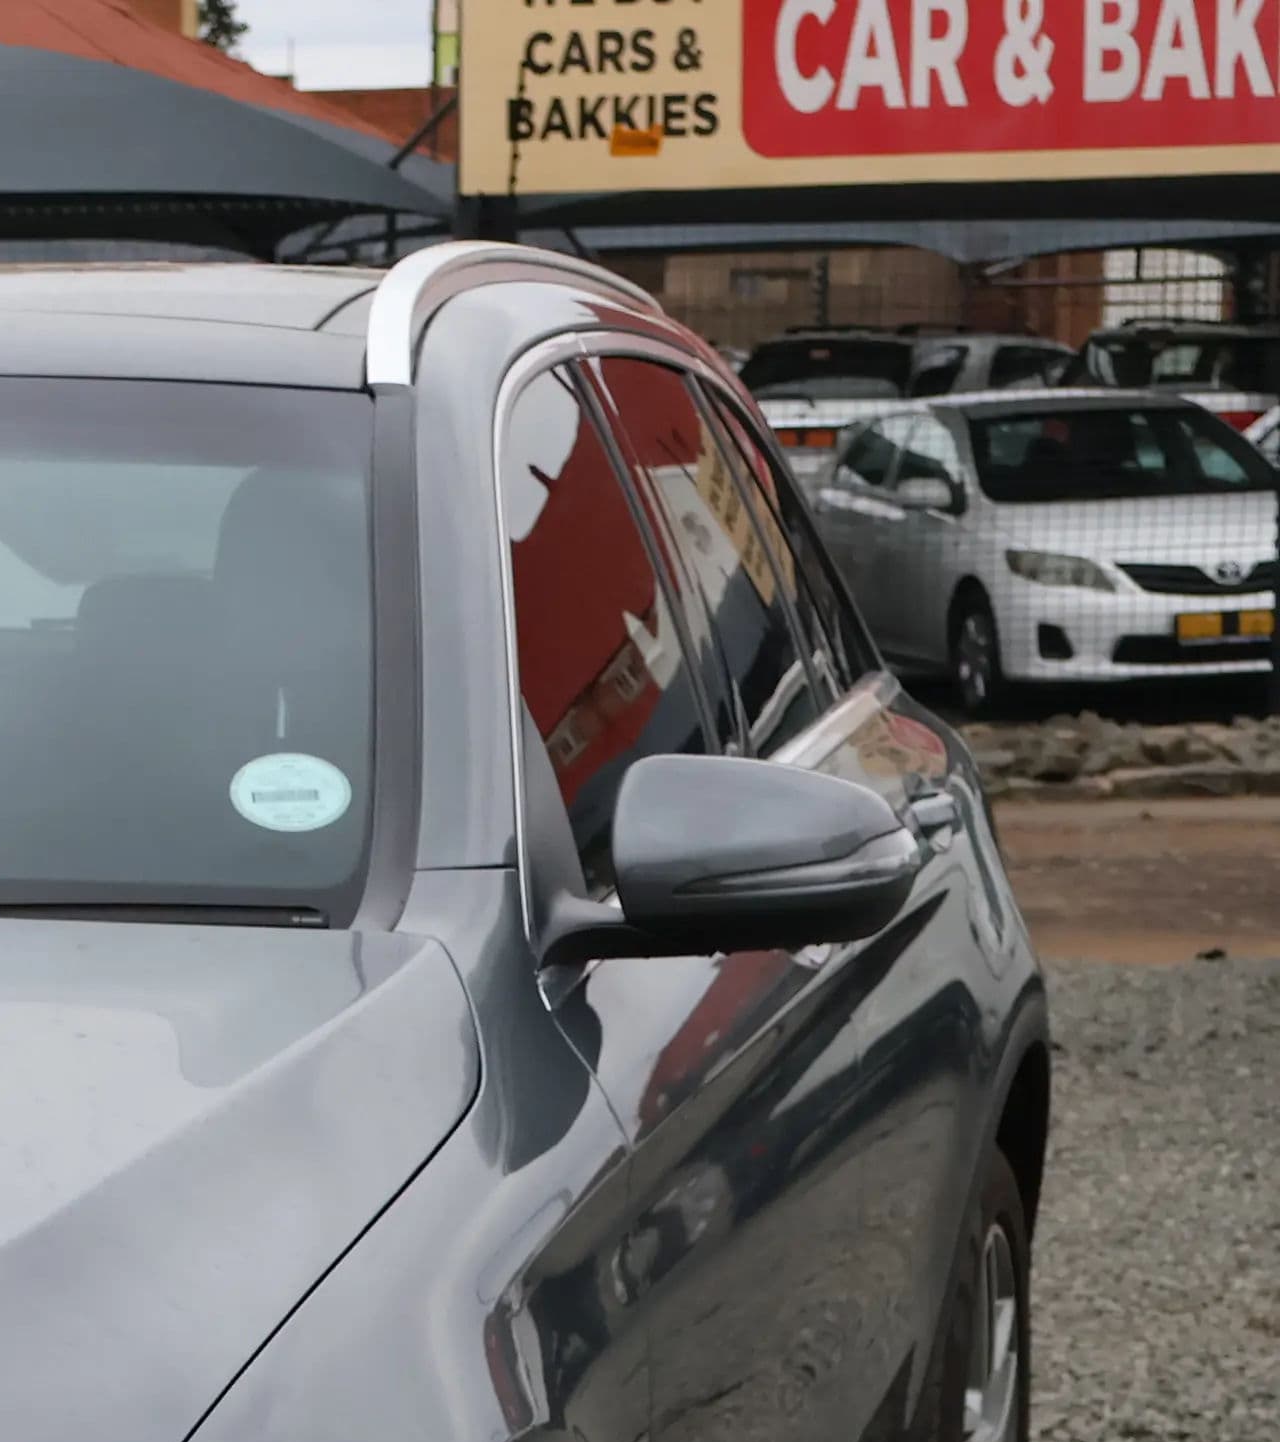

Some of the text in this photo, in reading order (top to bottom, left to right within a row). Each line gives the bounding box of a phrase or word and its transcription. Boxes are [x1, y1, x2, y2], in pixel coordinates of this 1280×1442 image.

[524, 28, 702, 75] CARS &
[775, 0, 969, 113] CAR
[993, 0, 1055, 107] &
[507, 94, 719, 141] BAKKIES
